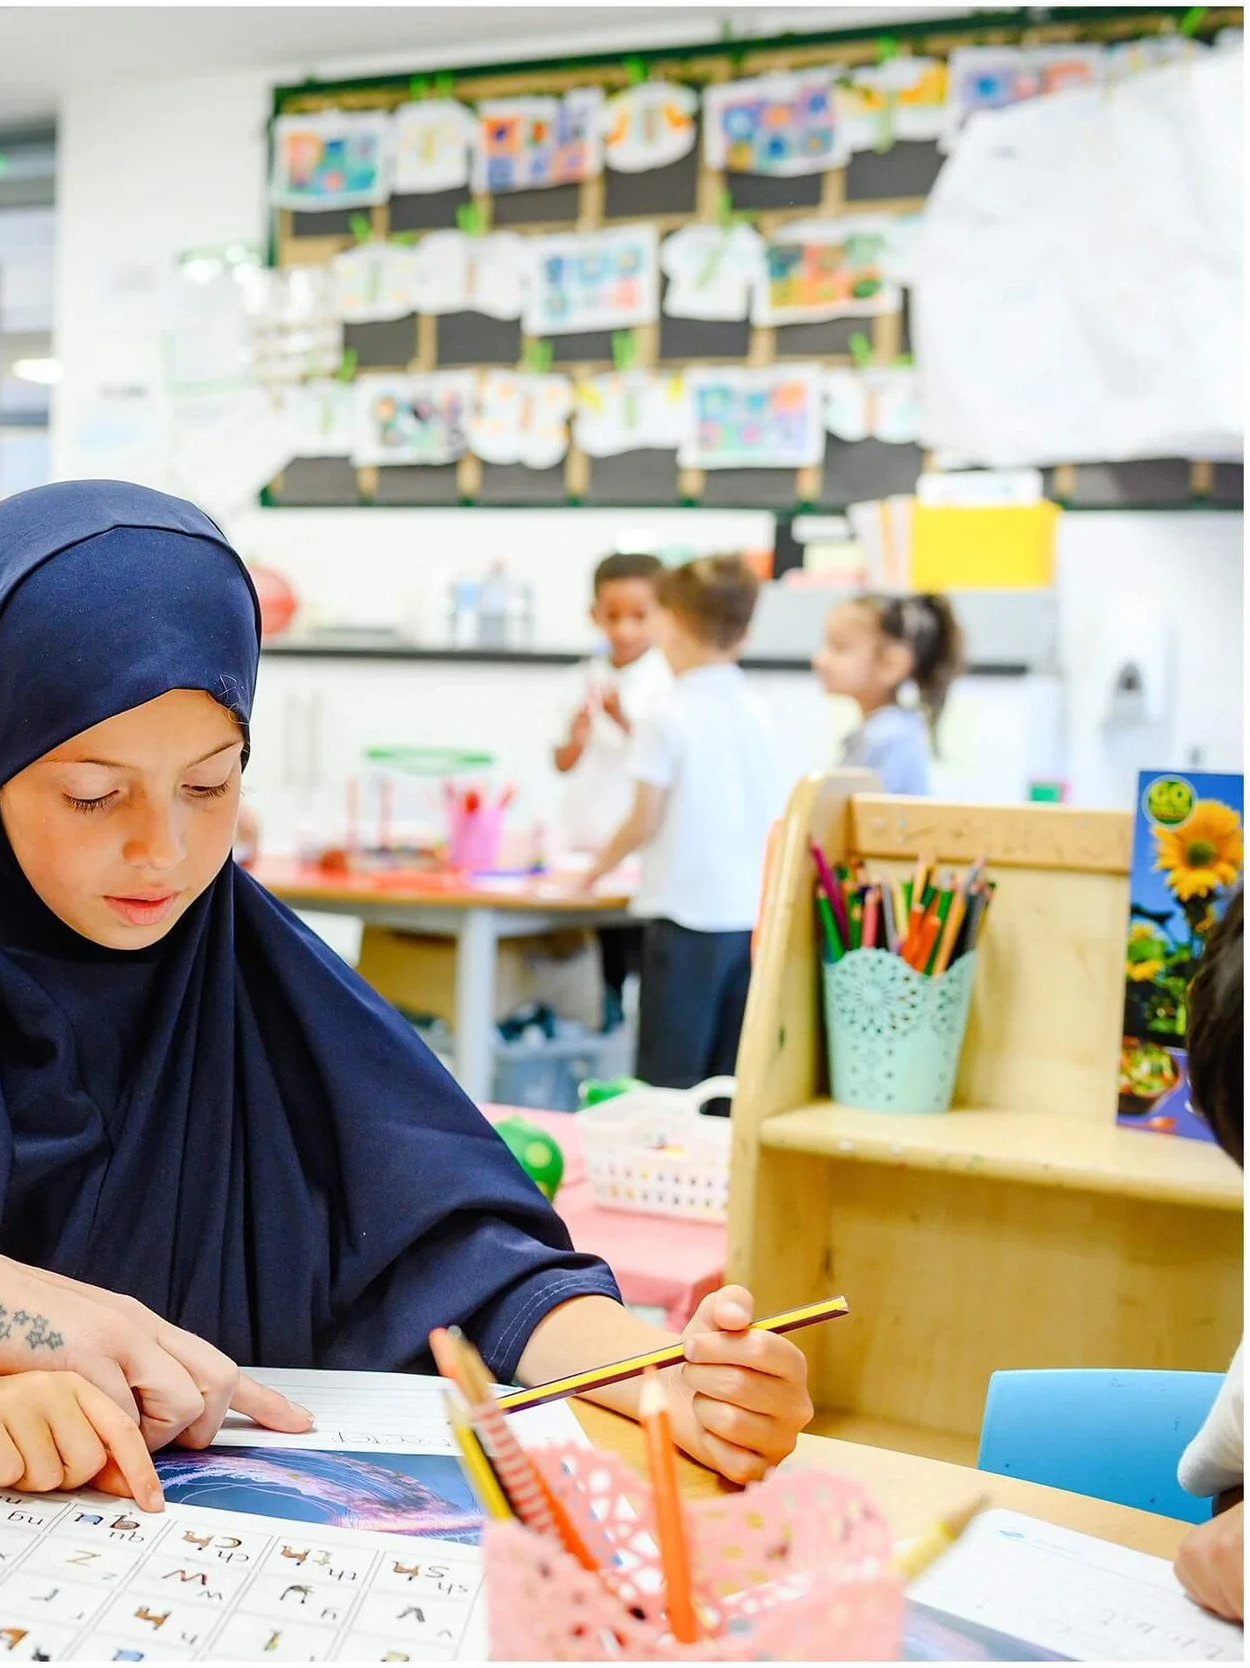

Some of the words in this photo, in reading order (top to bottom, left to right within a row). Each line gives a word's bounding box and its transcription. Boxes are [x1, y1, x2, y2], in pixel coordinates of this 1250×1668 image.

[7, 1511, 44, 1528] ng
[108, 1530, 145, 1544] qu
[64, 1549, 102, 1567] z
[218, 1550, 250, 1564] ch
[328, 1567, 357, 1582] th
[437, 1581, 469, 1595] sh
